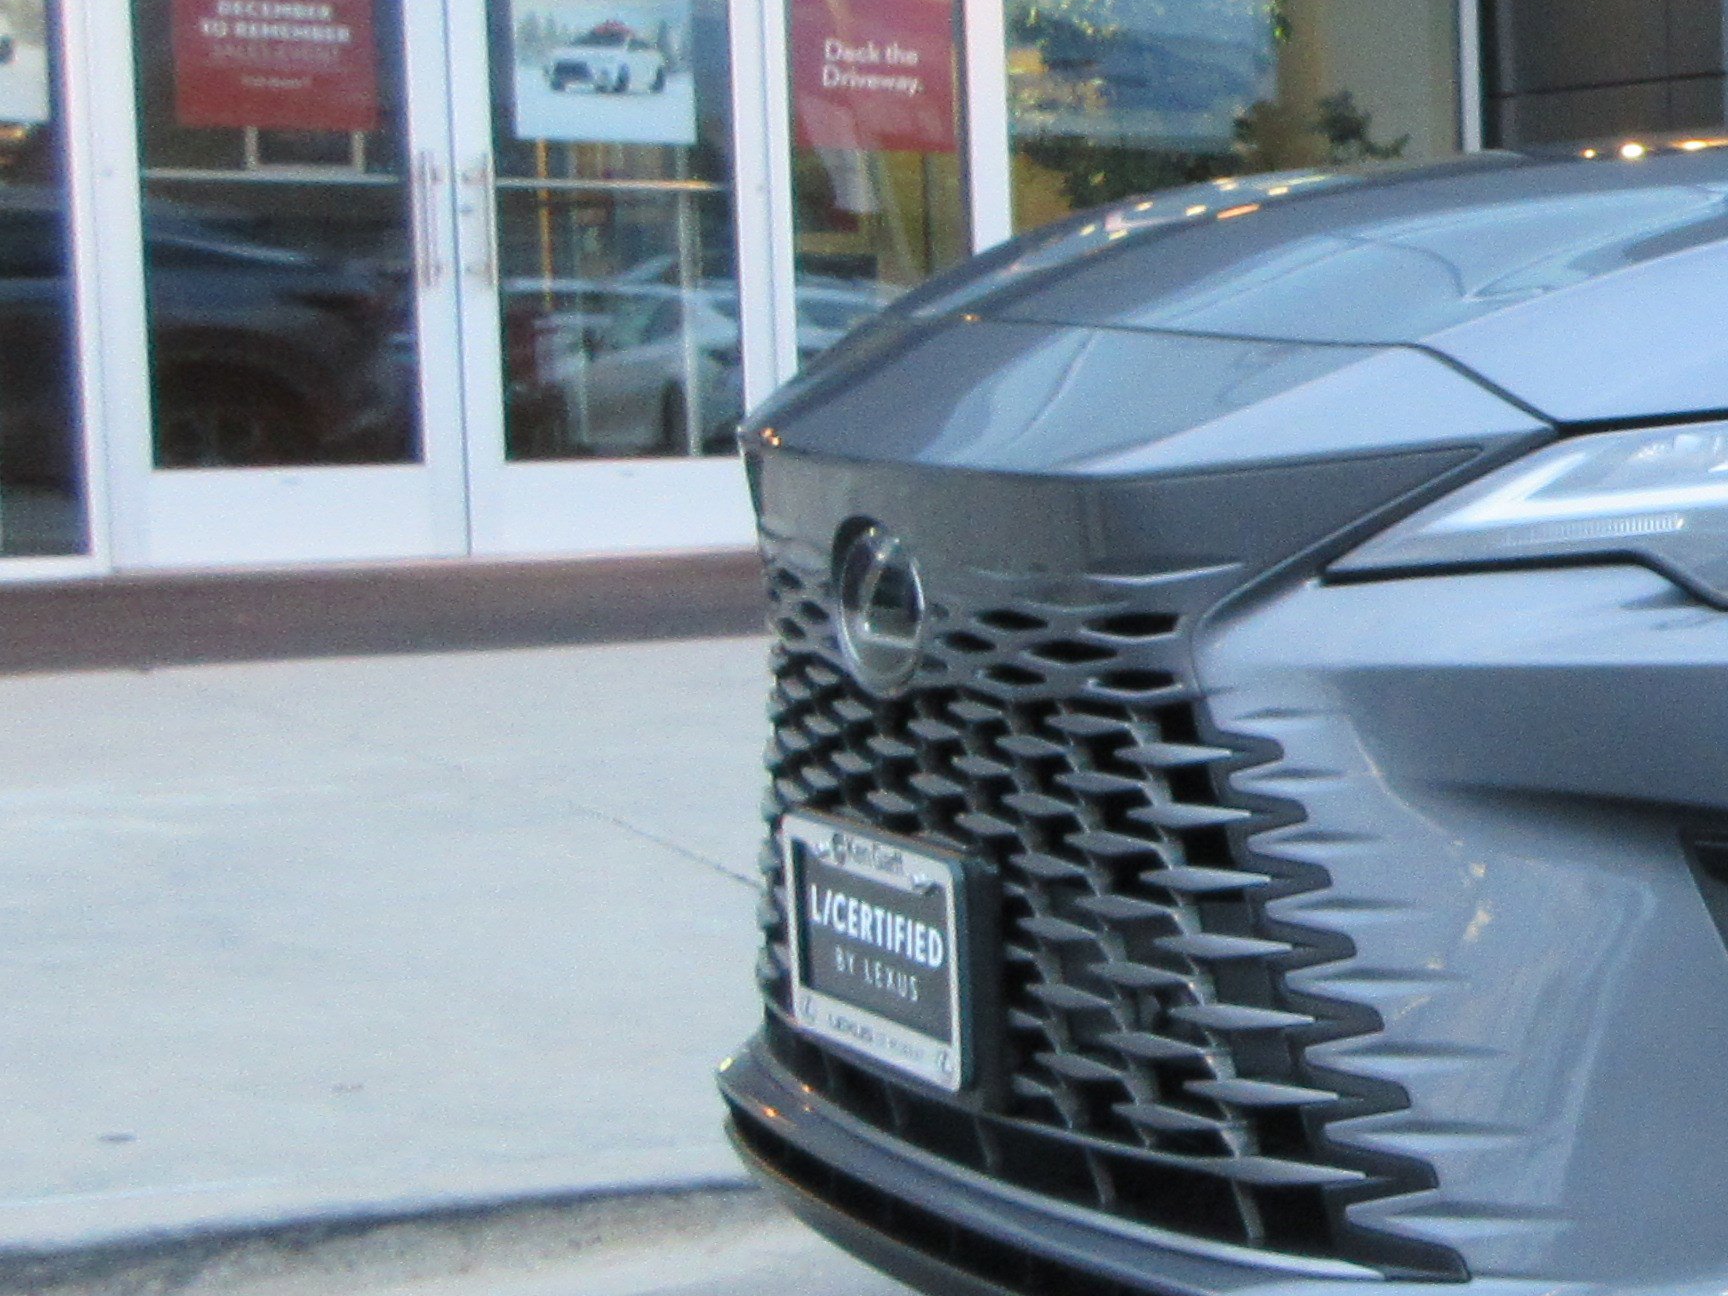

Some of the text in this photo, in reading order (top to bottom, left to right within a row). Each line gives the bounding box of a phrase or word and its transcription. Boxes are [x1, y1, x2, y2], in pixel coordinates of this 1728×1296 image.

[884, 40, 920, 67] the
[808, 883, 945, 970] L/CERTIFIED
[833, 945, 920, 1003] BY LEXUS
